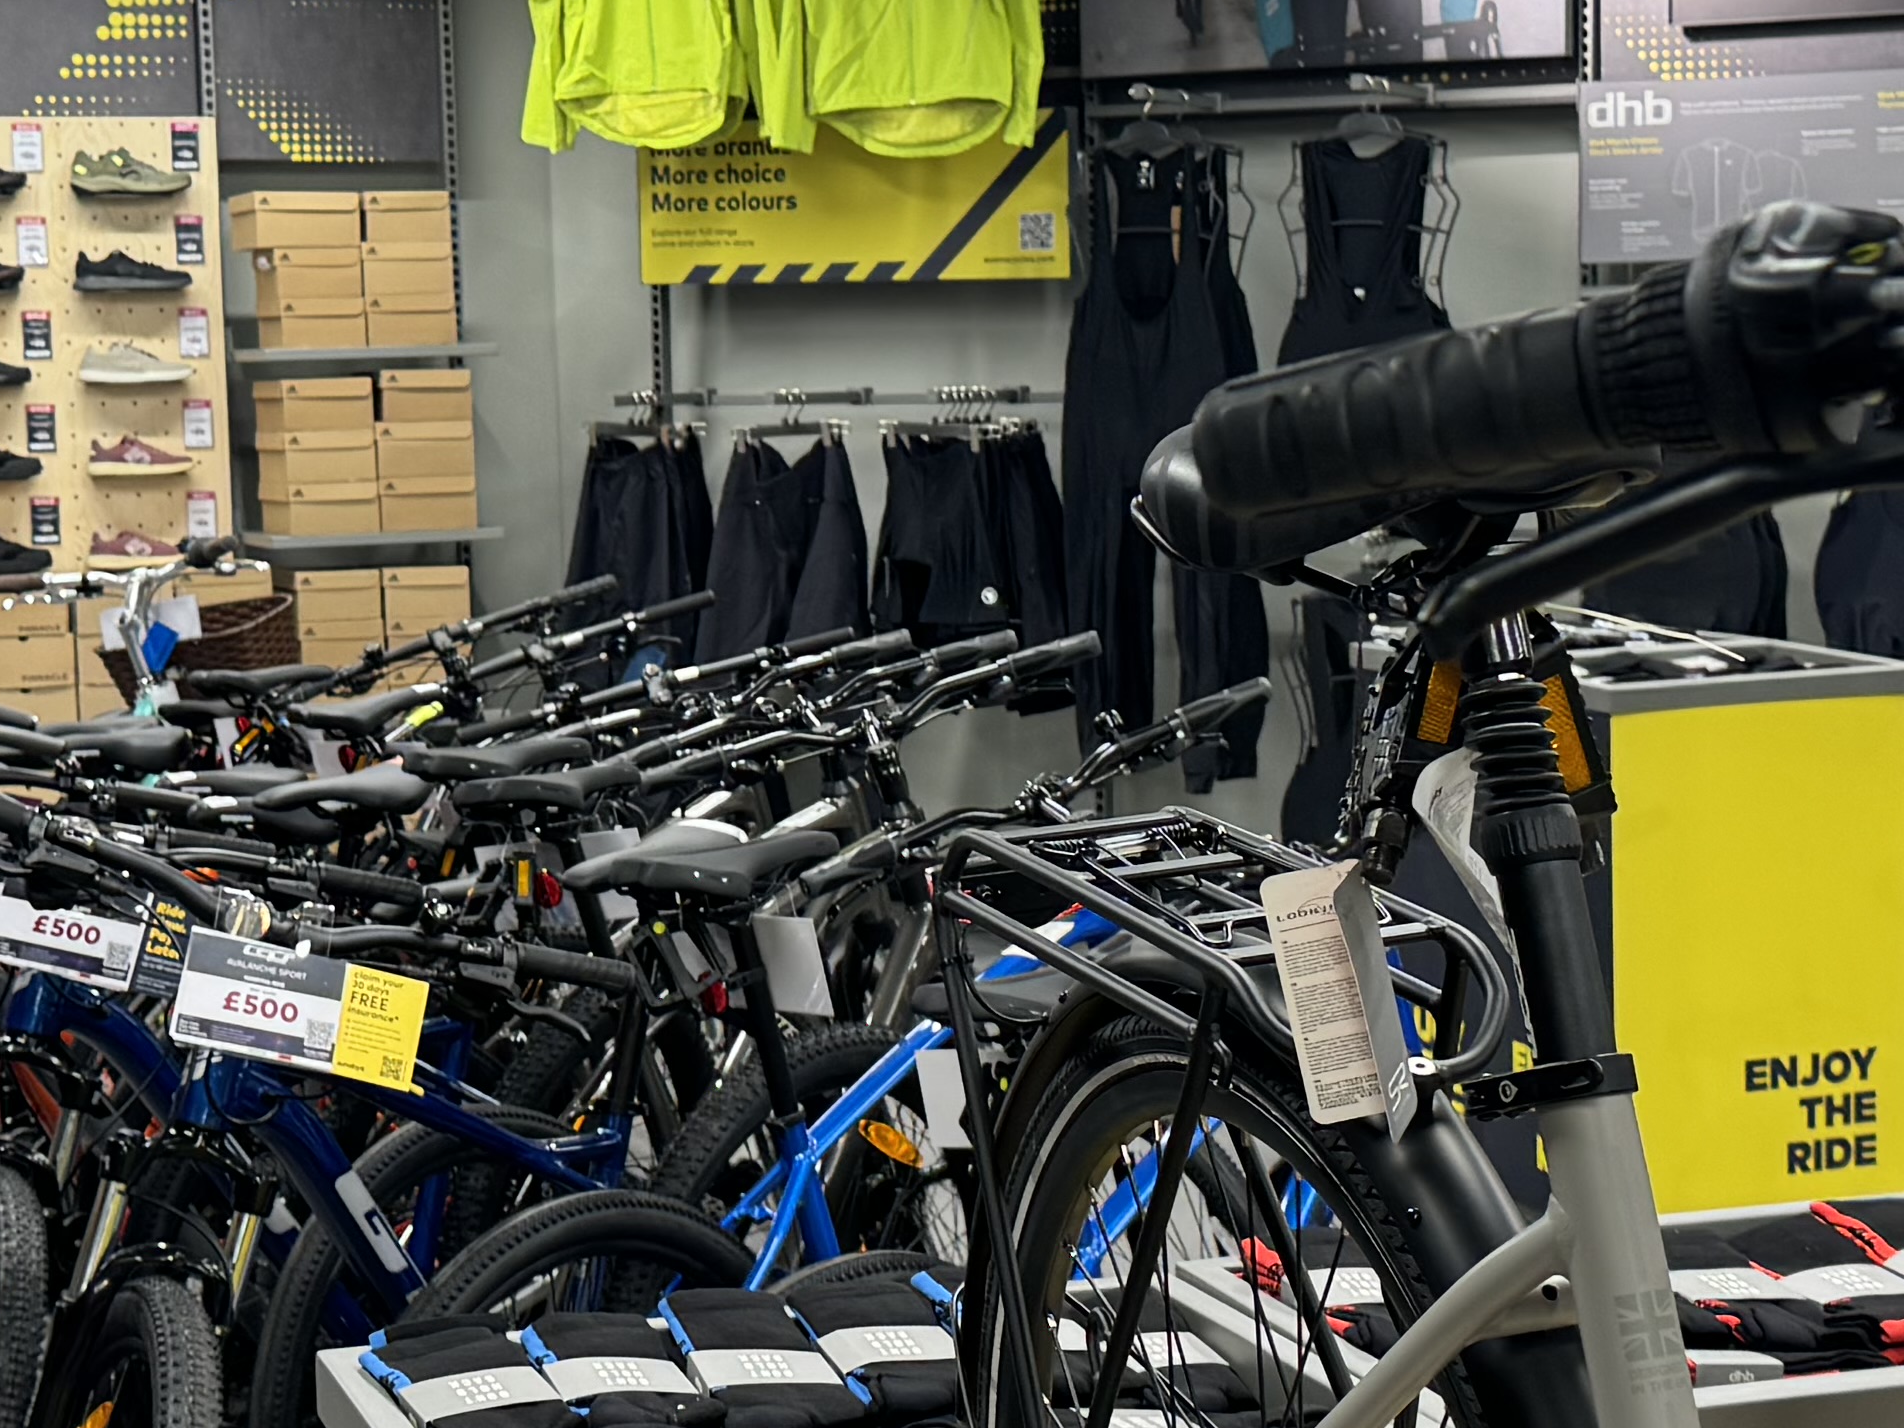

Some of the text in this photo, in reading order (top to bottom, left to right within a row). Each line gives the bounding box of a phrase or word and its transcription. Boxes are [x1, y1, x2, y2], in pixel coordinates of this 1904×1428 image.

[1587, 90, 1673, 128] dhb
[651, 164, 785, 183] More choice
[651, 191, 797, 212] More colours
[156, 900, 187, 920] Ride
[32, 914, 102, 947] £500
[226, 958, 277, 976] AVALANCHE
[354, 971, 404, 990] claim your
[366, 983, 390, 997] days
[222, 990, 299, 1023] £500
[350, 990, 389, 1012] FREE
[1744, 1046, 1877, 1093] ENJOY
[1799, 1090, 1877, 1130] THE
[1787, 1134, 1877, 1175] RIDE
[1729, 1369, 1755, 1384] dhb
